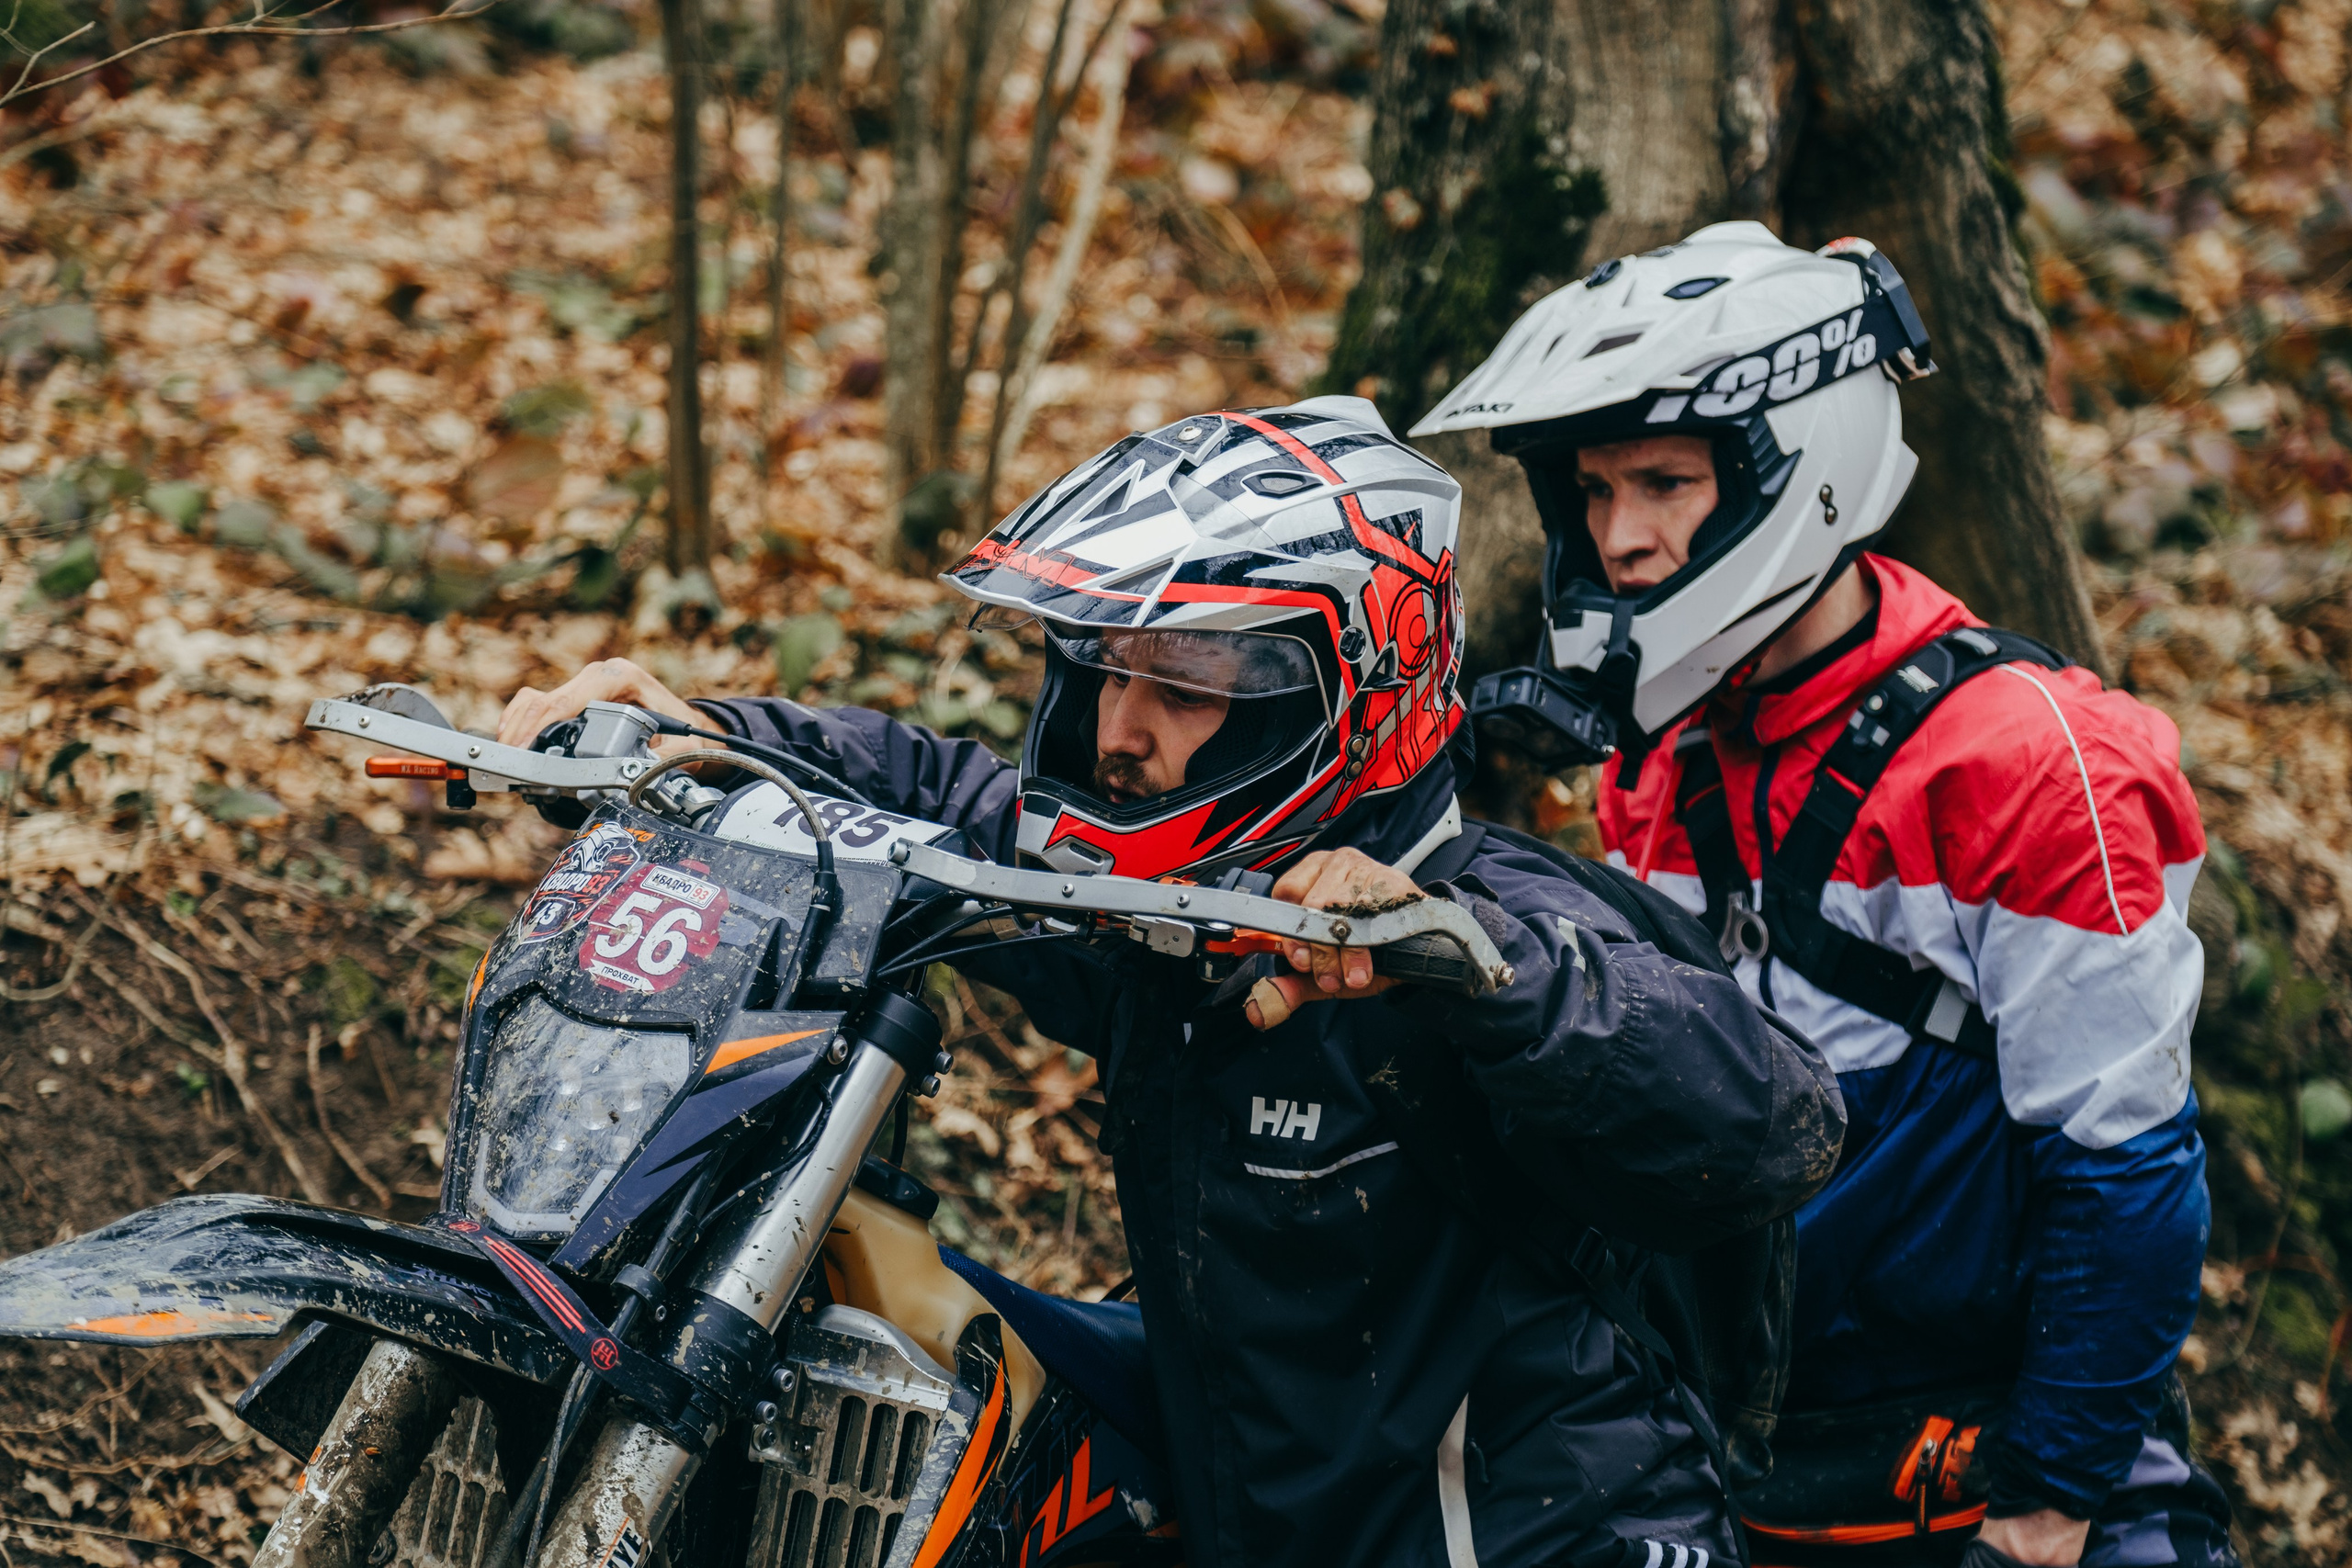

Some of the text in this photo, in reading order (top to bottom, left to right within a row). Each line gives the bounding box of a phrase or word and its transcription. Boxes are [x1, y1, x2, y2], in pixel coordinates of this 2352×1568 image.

[692, 887, 709, 901] 93
[594, 891, 703, 976] 56
[601, 965, 639, 985] ПРОХВАТ
[1250, 1096, 1321, 1141] HH
